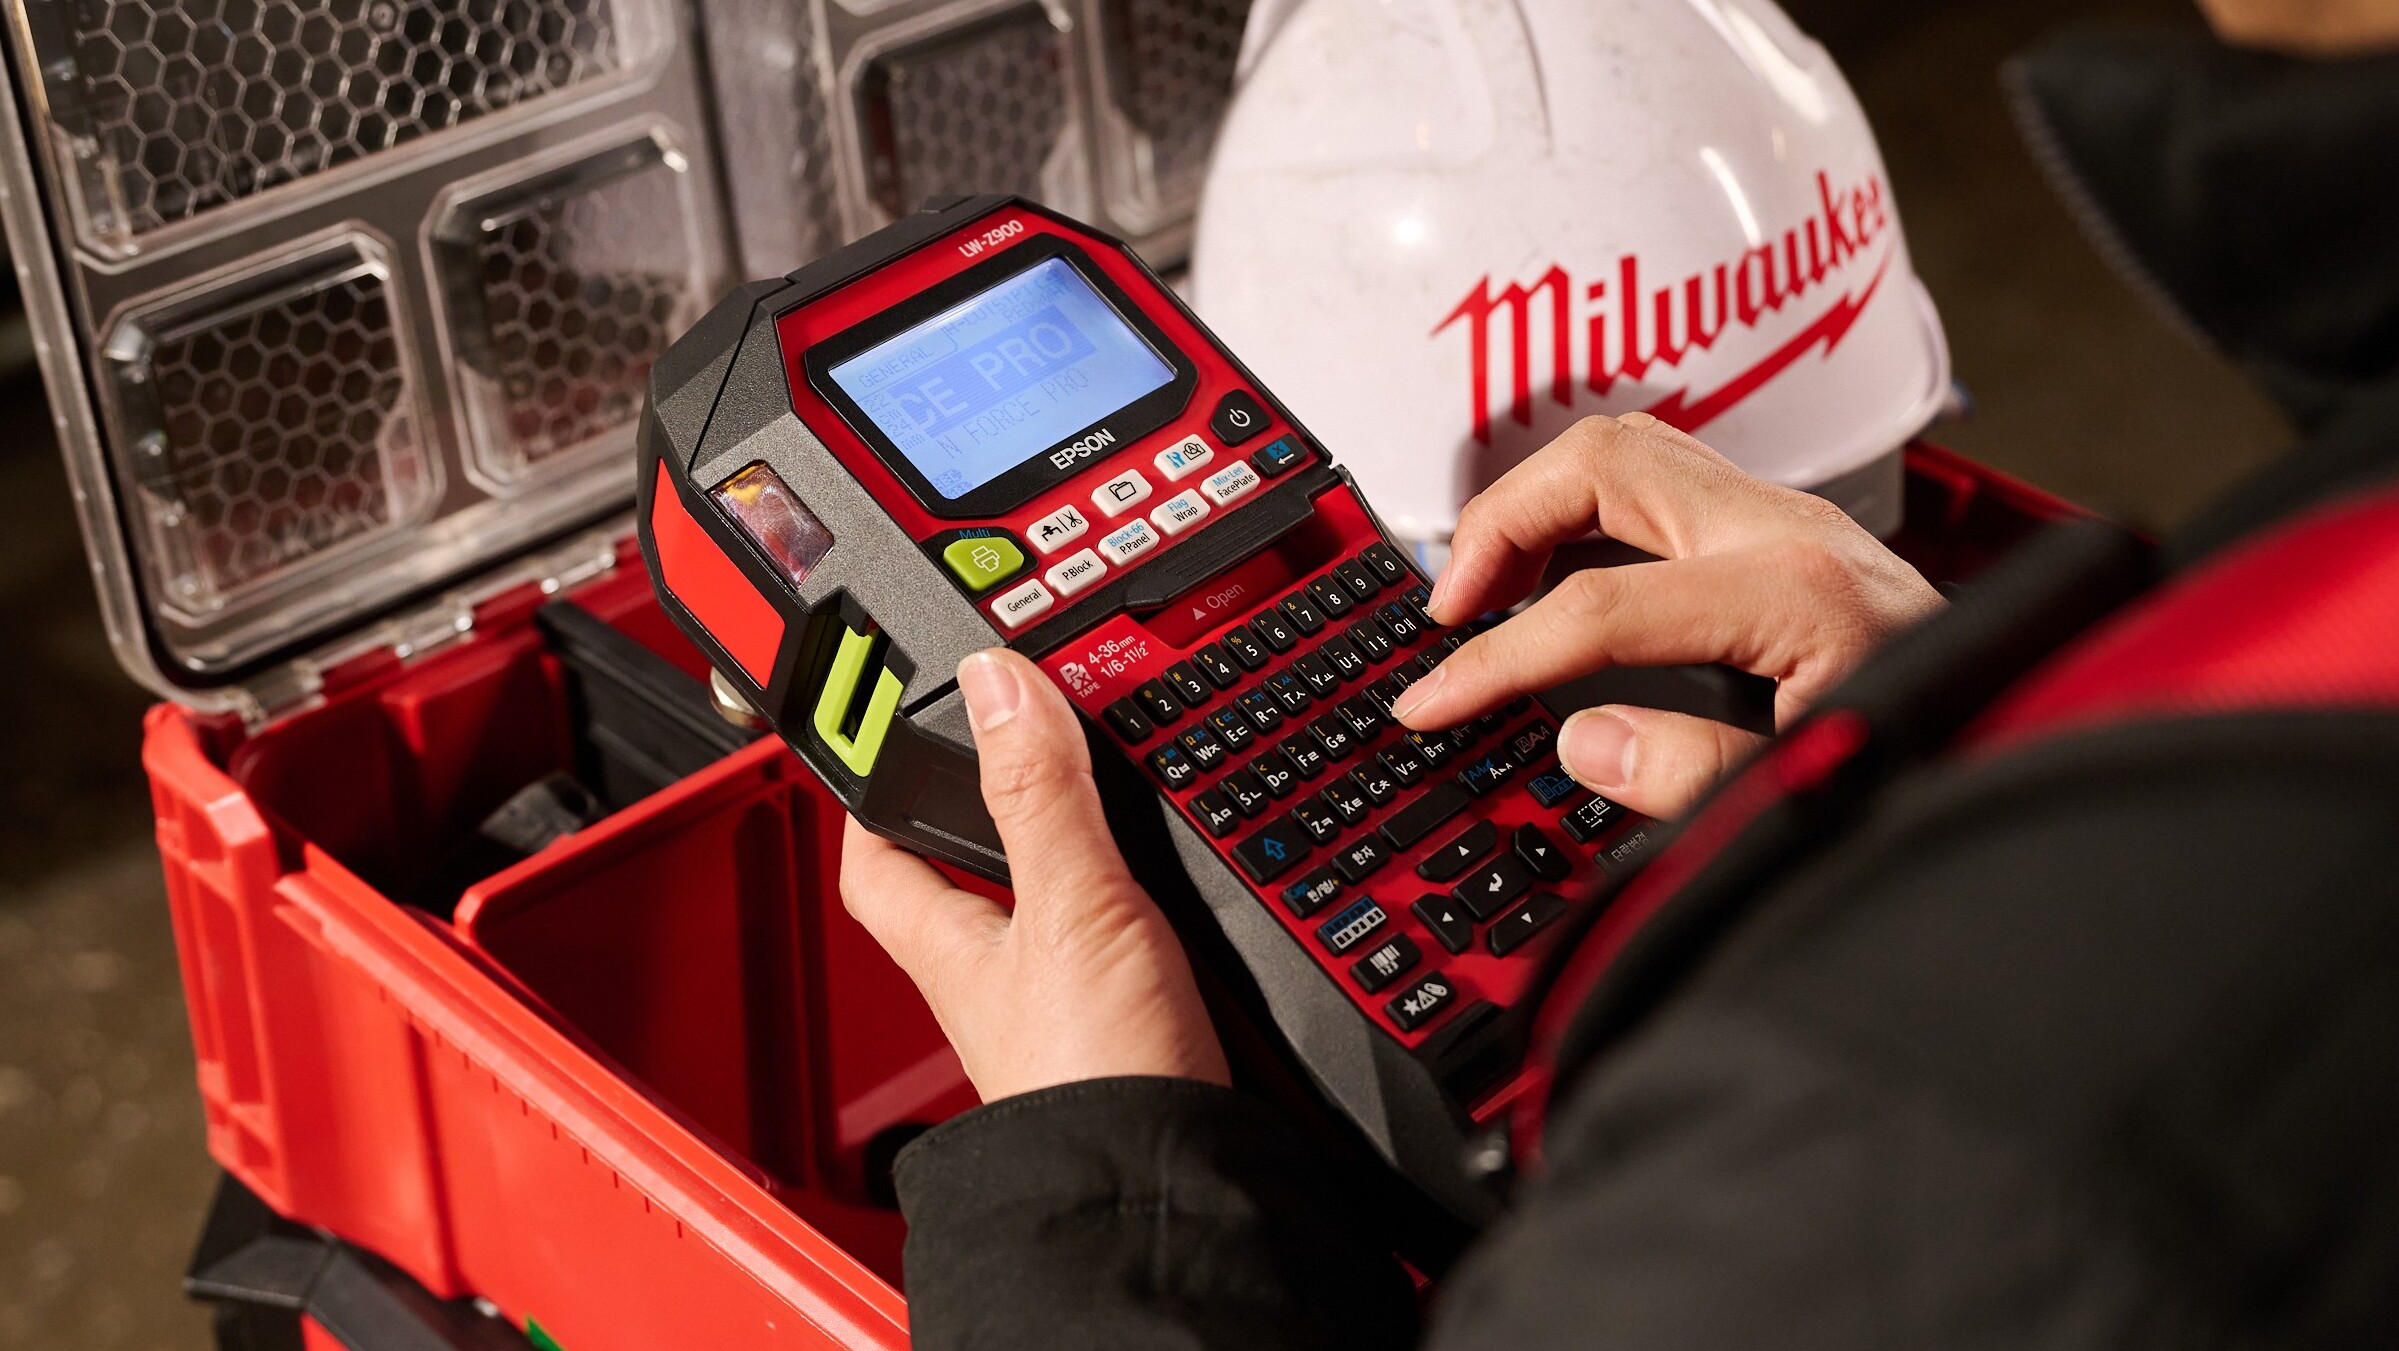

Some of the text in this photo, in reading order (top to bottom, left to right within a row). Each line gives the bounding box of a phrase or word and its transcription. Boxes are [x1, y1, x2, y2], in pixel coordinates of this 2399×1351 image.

[958, 219, 1024, 257] LW-Z900
[1430, 159, 1887, 446] Milwaukee
[969, 321, 1073, 391] PRO
[859, 347, 935, 388] GENERAL
[963, 395, 1041, 445] FORCE
[1040, 367, 1090, 403] PRO
[1049, 428, 1117, 471] EPSON
[1216, 473, 1256, 499] FacePlate
[1167, 498, 1190, 513] Flag
[1173, 505, 1199, 523] Wrap
[958, 528, 991, 540] Multi
[1107, 522, 1145, 548] Block-66
[1119, 532, 1151, 555] P.Panel
[1062, 559, 1094, 581] P.Block
[1355, 578, 1367, 590] 9
[1007, 588, 1042, 613] General
[1206, 584, 1245, 610] Open
[1329, 593, 1342, 605] 8
[1301, 610, 1312, 622] 7
[1274, 627, 1286, 639] 6
[1245, 644, 1258, 657] 5
[1219, 662, 1230, 674] 4
[1077, 682, 1101, 699] TAPE
[1188, 680, 1201, 693] 3
[1159, 699, 1172, 712] 2
[1130, 718, 1141, 729] 1
[1351, 844, 1376, 866] 한자
